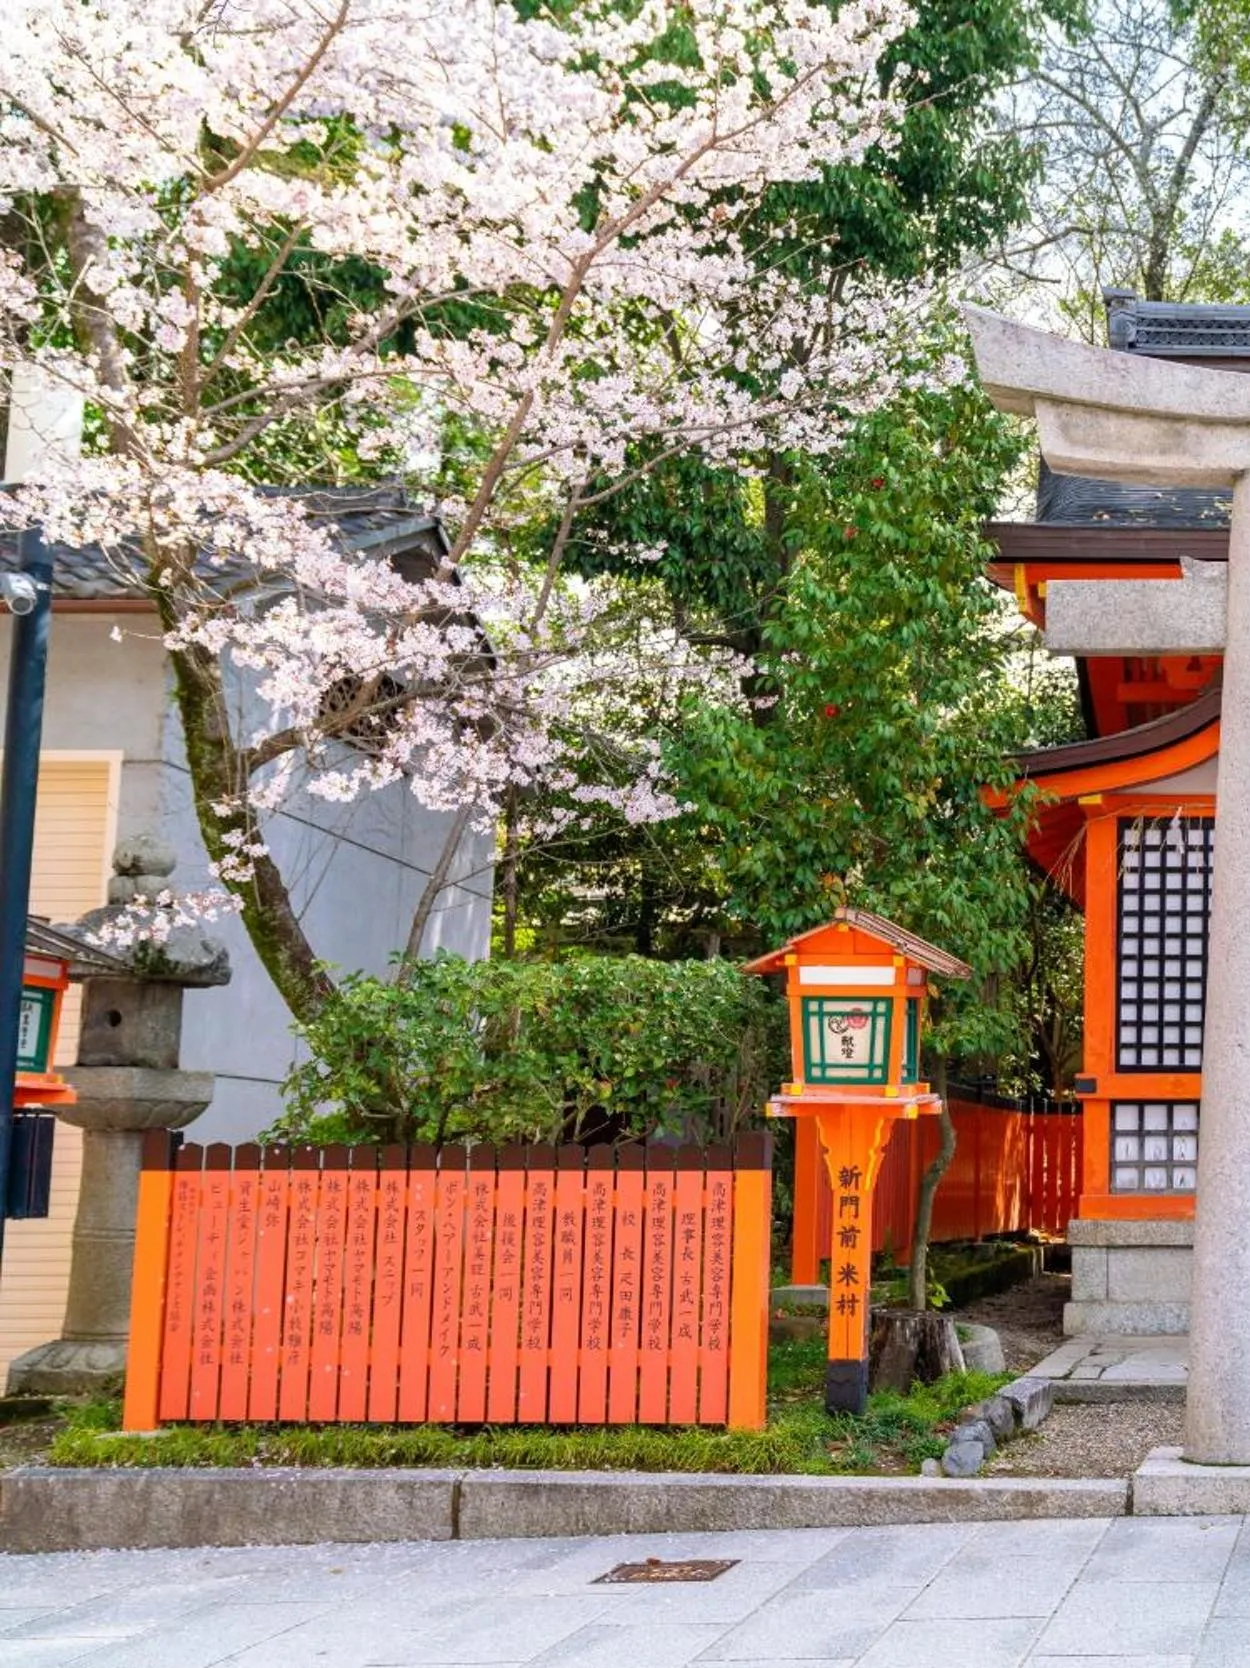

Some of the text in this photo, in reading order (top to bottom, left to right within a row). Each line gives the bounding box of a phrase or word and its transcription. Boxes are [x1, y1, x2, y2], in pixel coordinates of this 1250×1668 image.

[498, 1212, 518, 1302] 後援会一同
[559, 1210, 578, 1303] 教職員一同
[681, 1212, 697, 1262] 理事長
[836, 1165, 862, 1317] 新門前 米村
